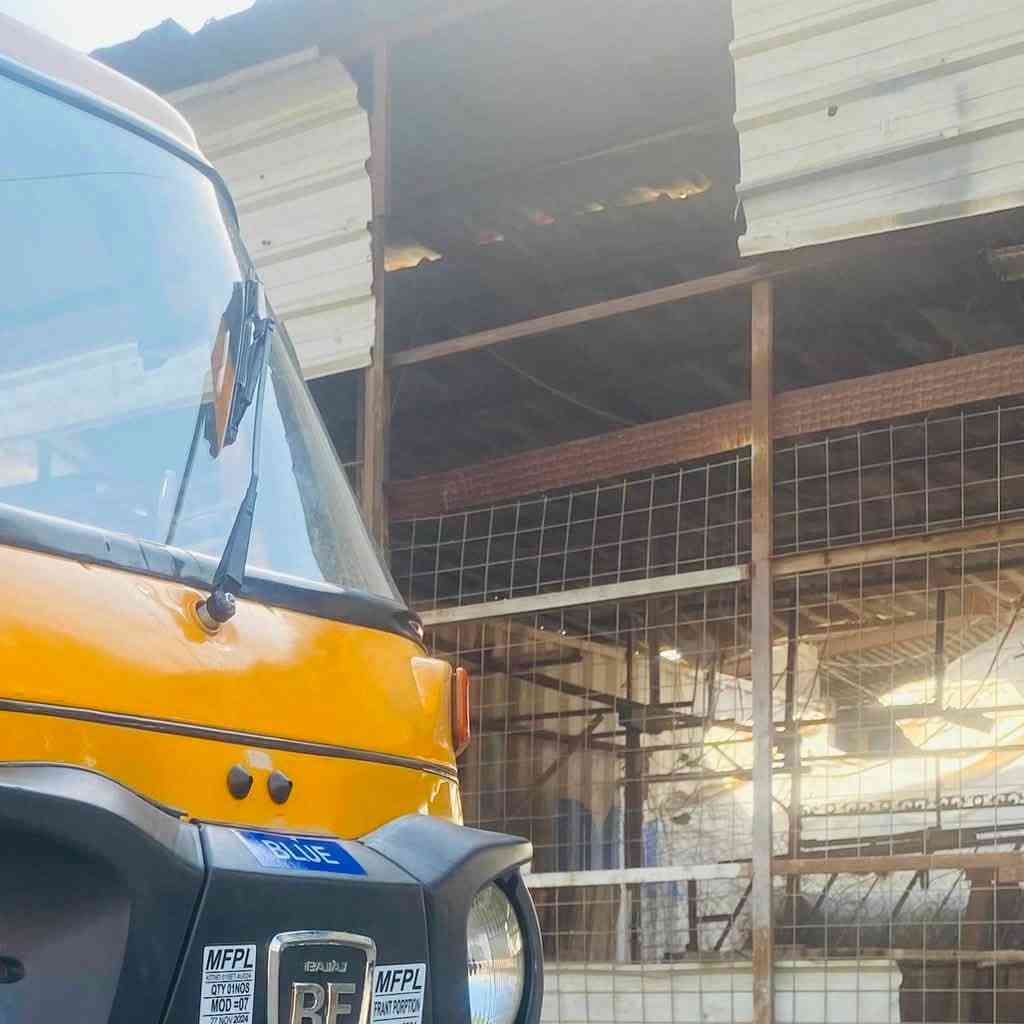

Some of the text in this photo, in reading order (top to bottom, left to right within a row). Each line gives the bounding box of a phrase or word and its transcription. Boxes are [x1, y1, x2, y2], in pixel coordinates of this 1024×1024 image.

[262, 839, 340, 864] BLUE
[206, 948, 253, 970] MFPL
[211, 983, 226, 995] QTY
[375, 968, 422, 993] MFPL
[211, 998, 232, 1012] MOD
[218, 1016, 233, 1024] NOV
